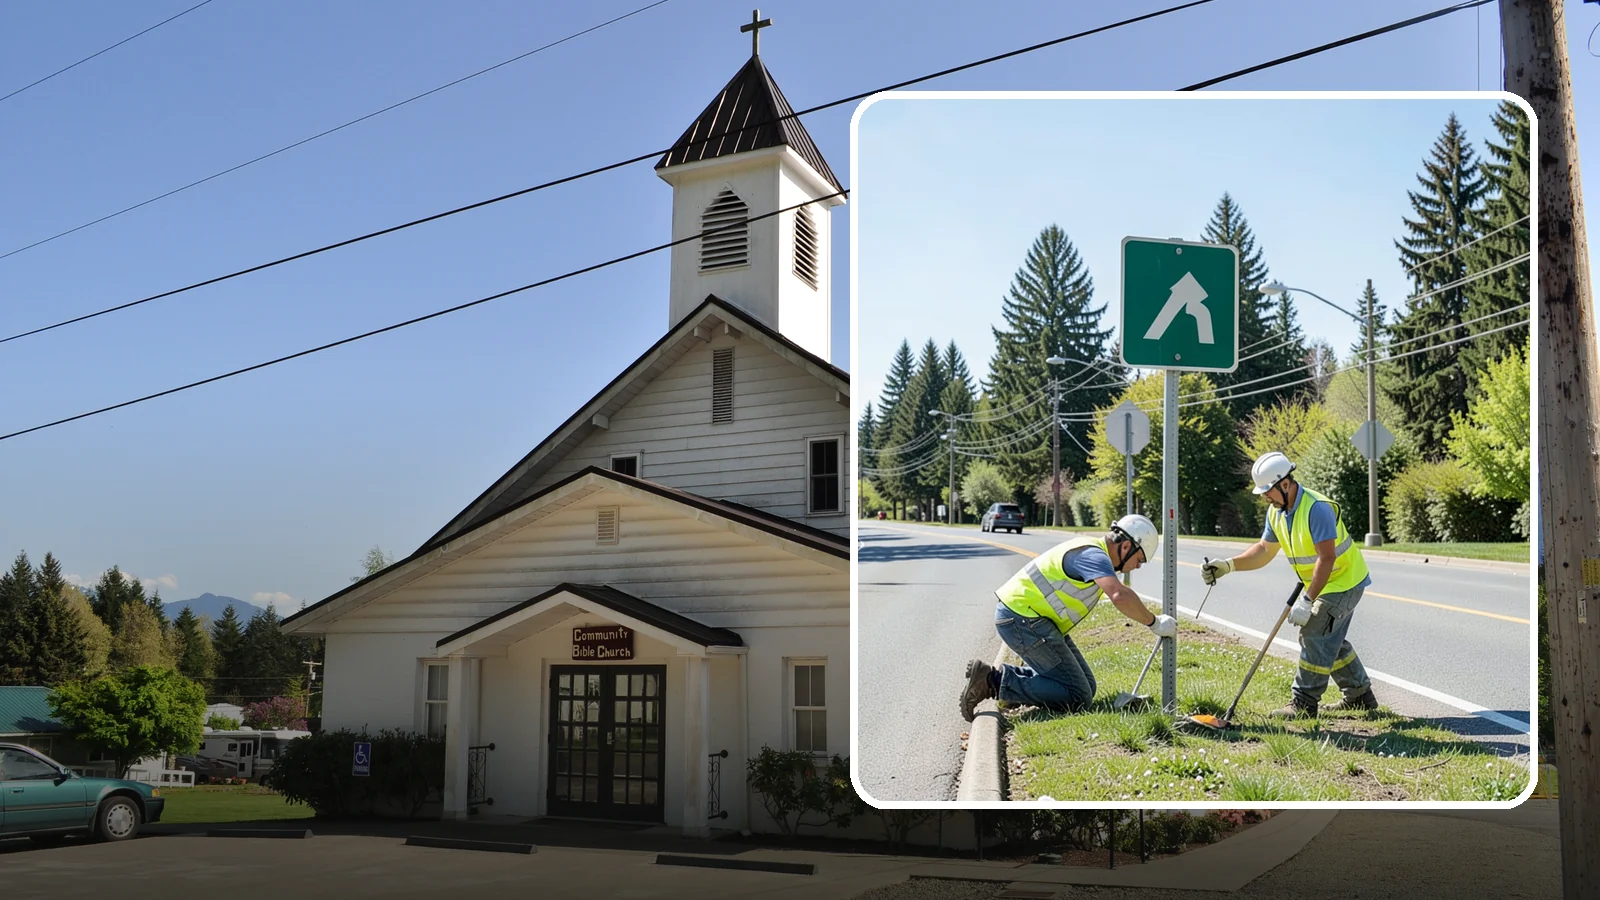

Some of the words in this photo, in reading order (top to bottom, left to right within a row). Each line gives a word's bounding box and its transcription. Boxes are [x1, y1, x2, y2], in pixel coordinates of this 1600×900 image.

[574, 627, 628, 641] Community
[572, 645, 595, 657] Bible
[597, 645, 631, 658] Church
